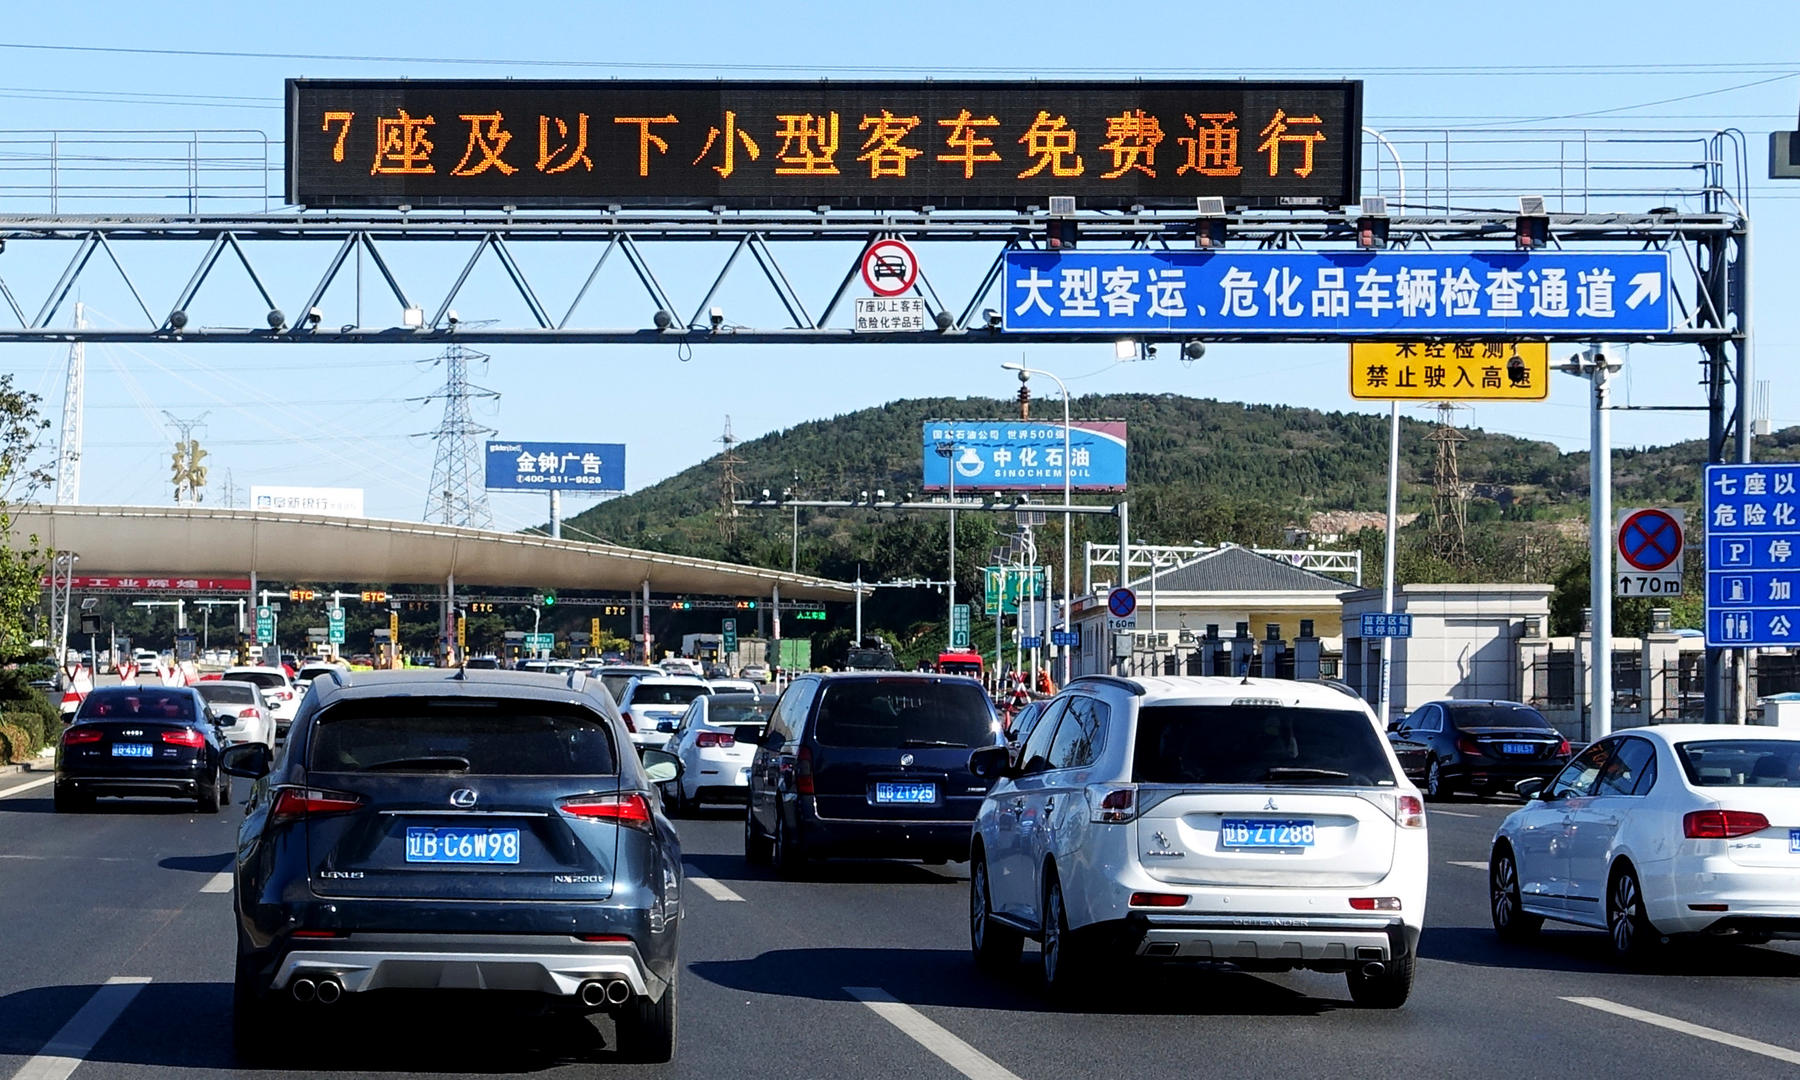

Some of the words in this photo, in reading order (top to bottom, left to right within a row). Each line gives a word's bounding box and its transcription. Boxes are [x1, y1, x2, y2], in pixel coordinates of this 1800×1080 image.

[322, 108, 1327, 178] 7座及以下小型客车免费通行
[1014, 267, 1616, 319] 大型客运、危化品车辆检查通道
[857, 300, 922, 313] 7座以上客车
[857, 316, 922, 329] 危险化学品车
[932, 429, 999, 441] 国家石油公司
[516, 451, 603, 474] 金钟广告
[993, 447, 1091, 468] 中化石油
[994, 469, 1063, 478] SINOCHEM
[1069, 469, 1091, 478] OIL
[1713, 472, 1796, 495] 七座以
[1713, 502, 1796, 527] 危险化
[1768, 539, 1792, 563] 停
[1636, 576, 1680, 593] 70m
[1768, 578, 1791, 601] 加
[291, 591, 314, 600] ETC
[362, 592, 386, 602] ETC
[471, 603, 494, 612] ETC
[605, 606, 626, 616] ETC
[1768, 615, 1792, 637] 公
[409, 831, 518, 858] 辽B·C6W98
[1232, 919, 1309, 927] OUTLANDER
